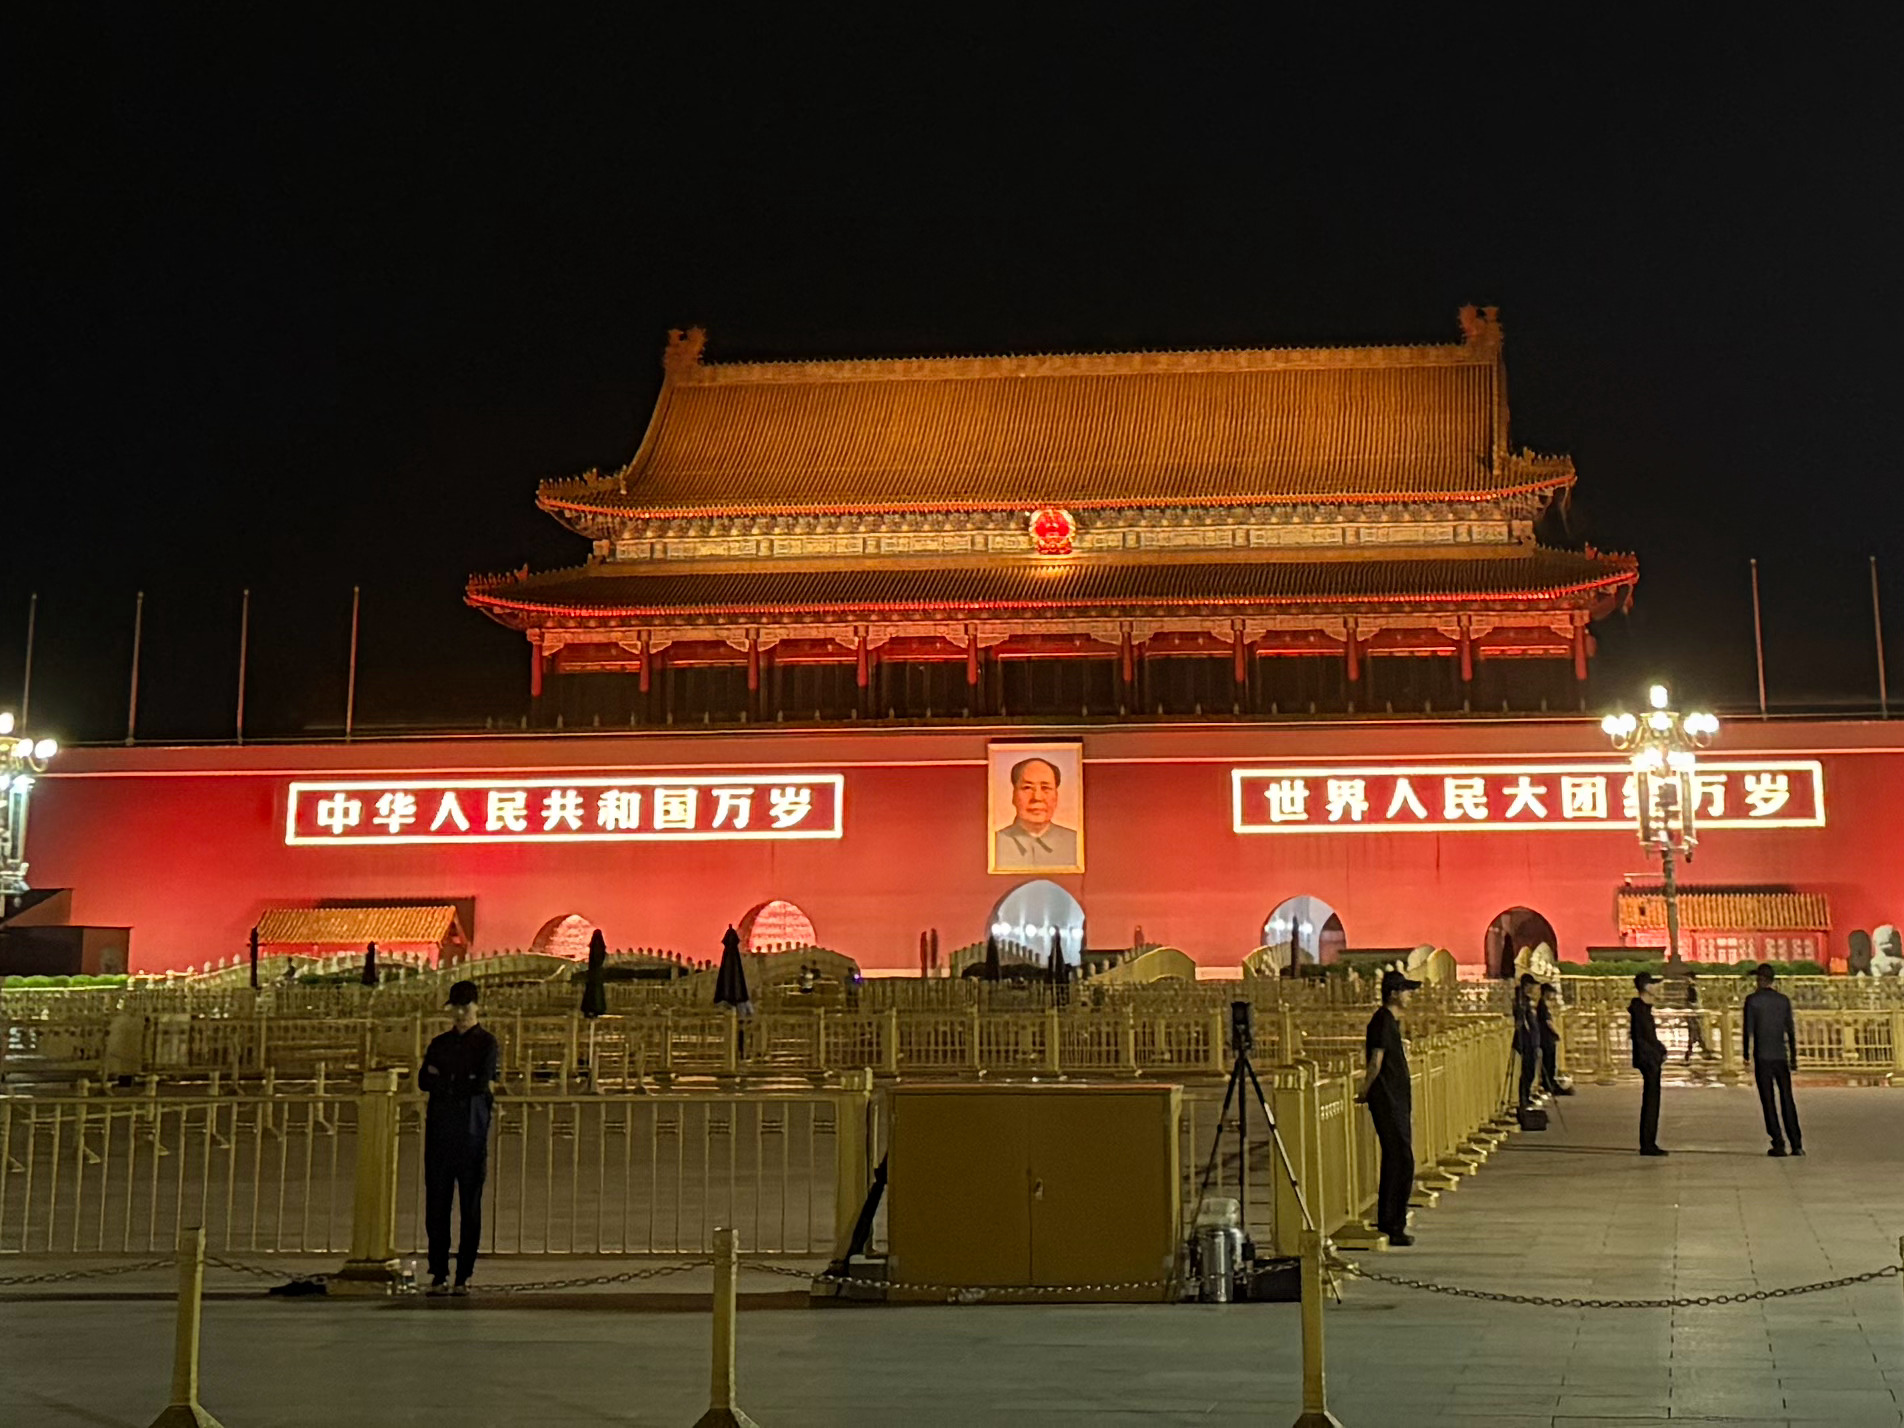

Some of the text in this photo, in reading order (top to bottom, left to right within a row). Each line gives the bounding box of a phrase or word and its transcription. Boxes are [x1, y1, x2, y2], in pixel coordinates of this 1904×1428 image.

[315, 787, 813, 834] 中华人民共和国万岁
